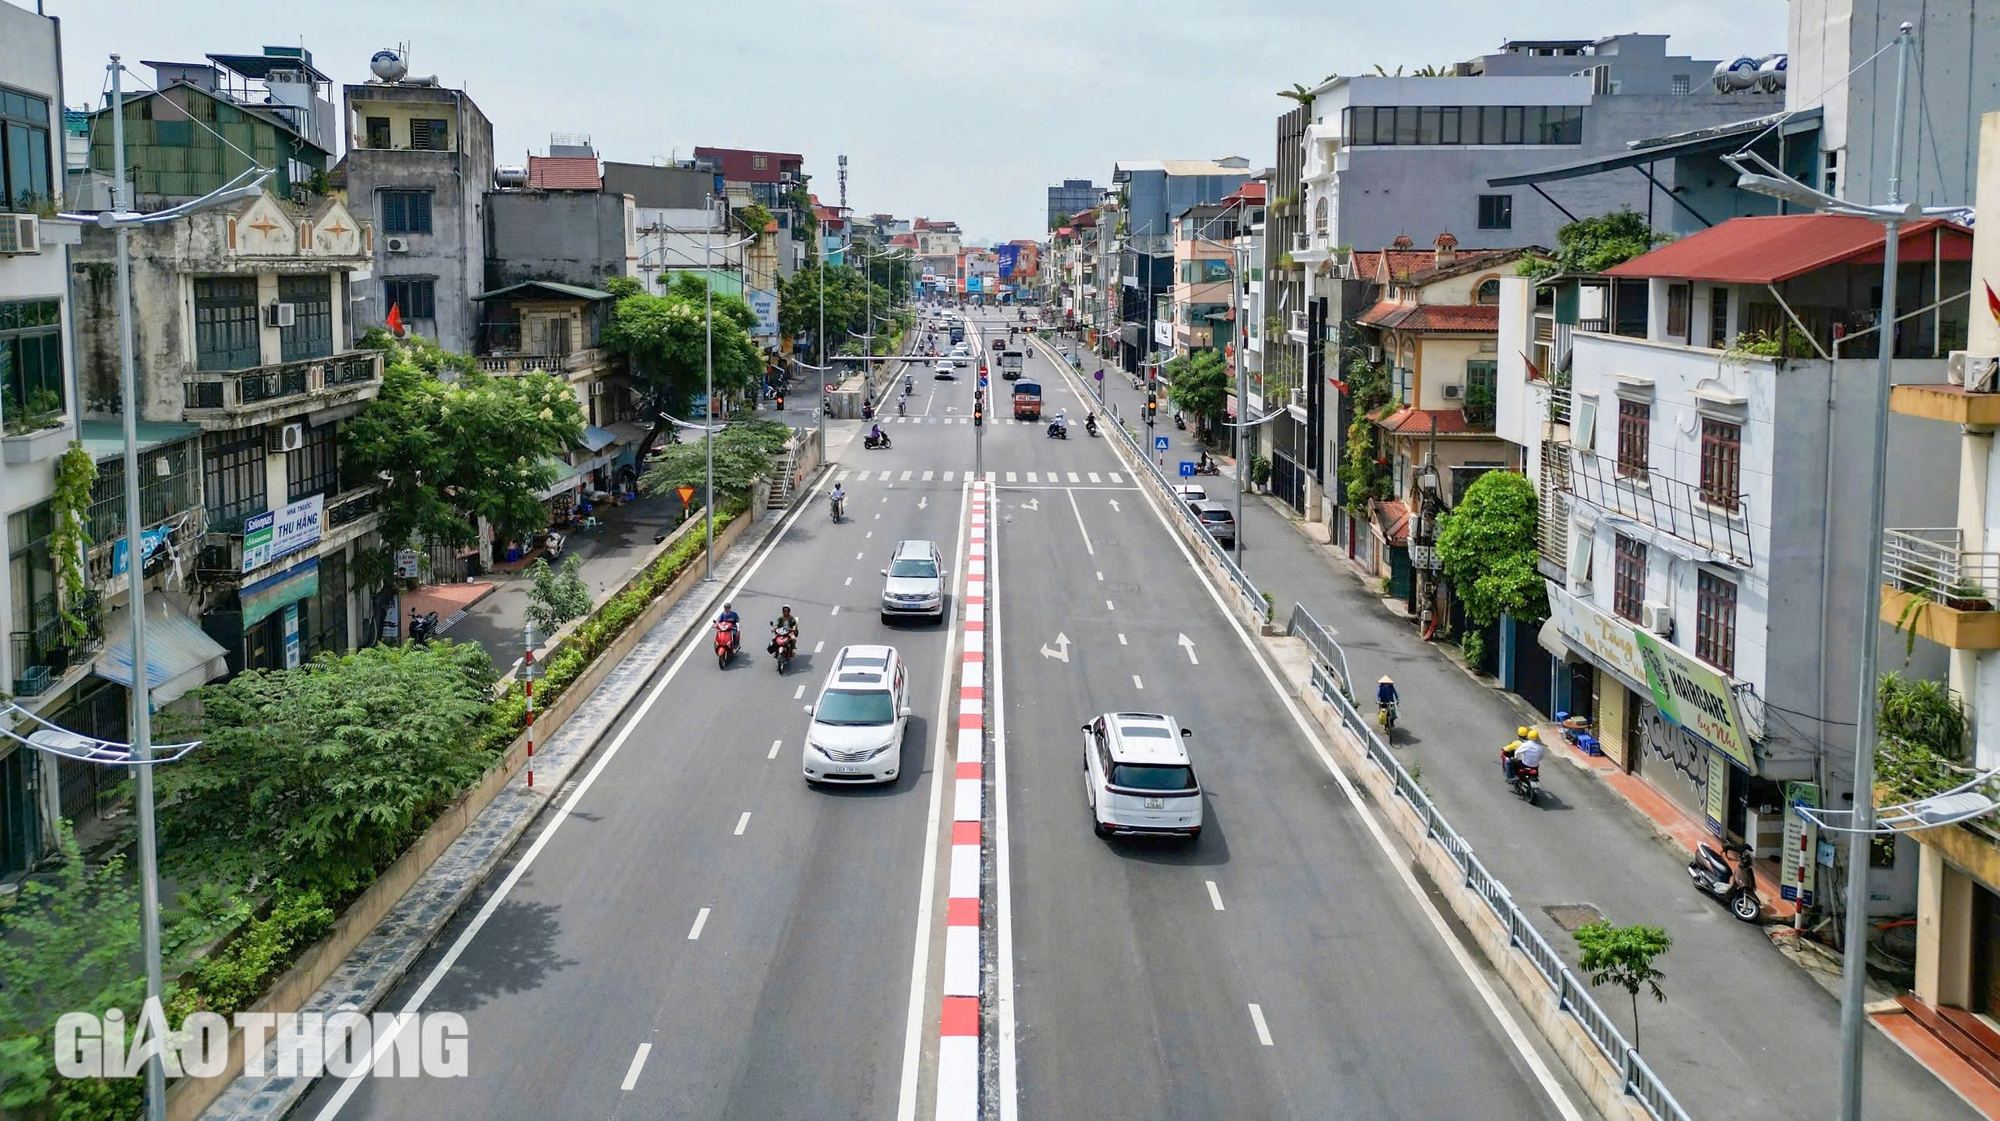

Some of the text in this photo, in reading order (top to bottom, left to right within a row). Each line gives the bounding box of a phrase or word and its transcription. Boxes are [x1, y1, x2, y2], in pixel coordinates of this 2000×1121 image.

[278, 520, 295, 538] THU
[1668, 668, 1731, 728] HAIRCARE
[1696, 713, 1711, 737] by
[1711, 722, 1738, 751] Nhi
